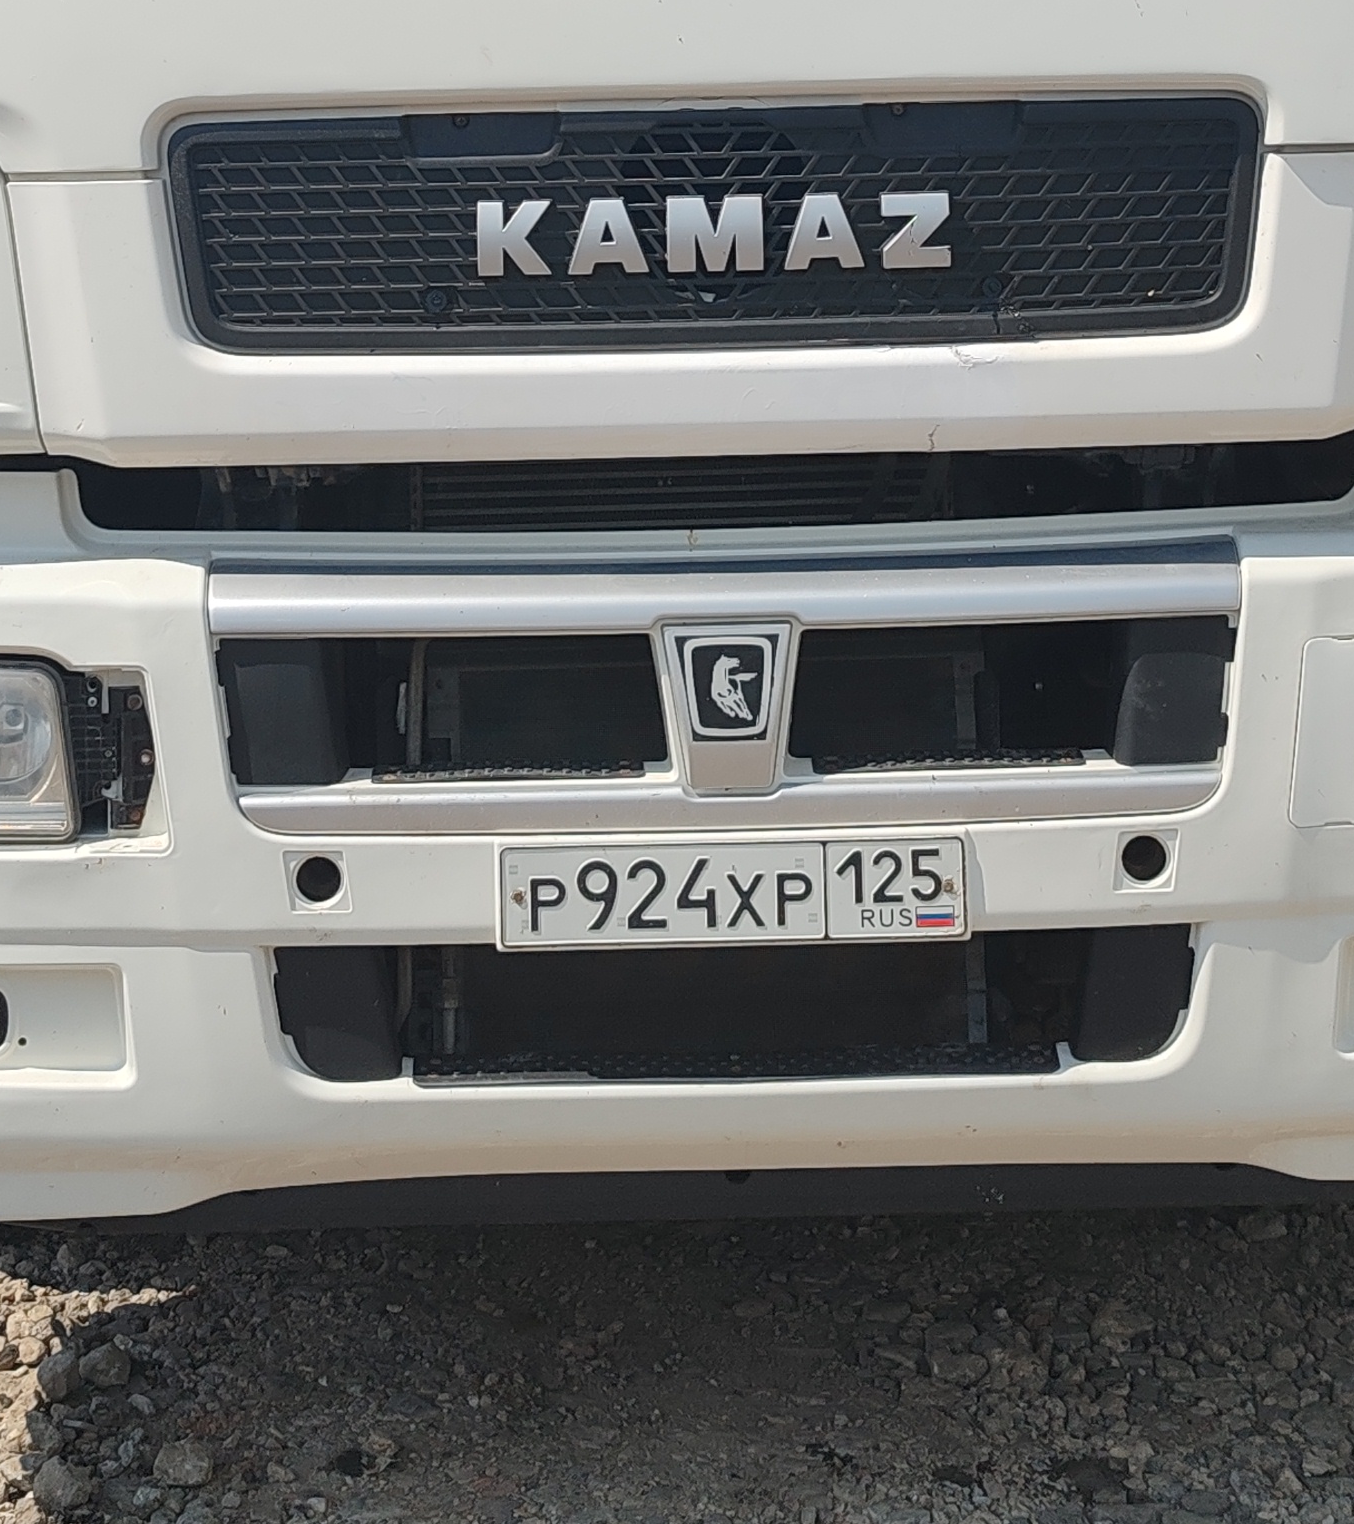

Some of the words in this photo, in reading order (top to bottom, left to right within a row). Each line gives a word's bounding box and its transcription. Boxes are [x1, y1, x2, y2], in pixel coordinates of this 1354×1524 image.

[475, 190, 952, 277] KAMAZ
[834, 848, 942, 904] 125
[860, 907, 913, 928] RUS
